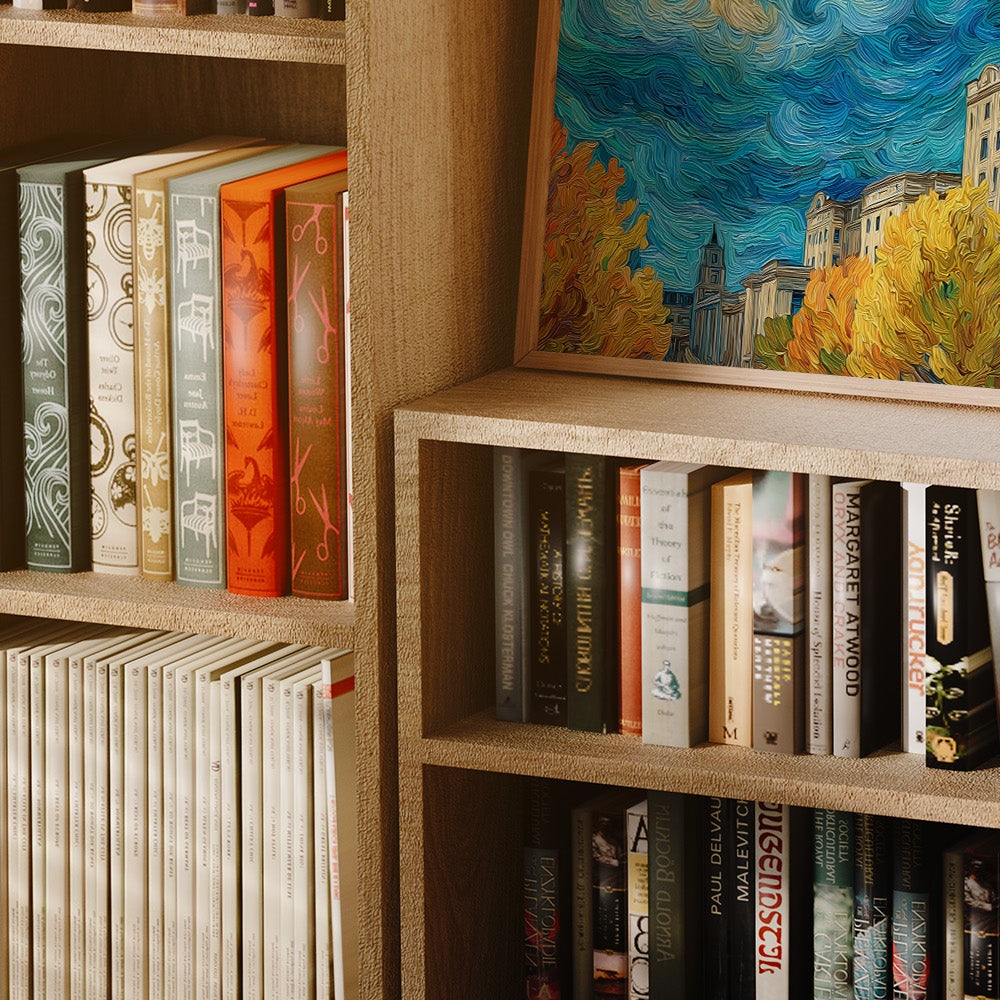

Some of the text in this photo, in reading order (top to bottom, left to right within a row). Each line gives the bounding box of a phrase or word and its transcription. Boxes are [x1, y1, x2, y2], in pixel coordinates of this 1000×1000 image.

[661, 503, 671, 513] of
[943, 503, 962, 565] Shriek:
[502, 455, 514, 690] DOWNTOWN OWL CHUCK KLOSTERMAN
[650, 537, 682, 551] Theory
[650, 570, 682, 581] Fiction
[834, 492, 846, 670] ORYX AND CRAKE
[845, 493, 860, 697] MARGARET ATWOOD
[812, 590, 822, 624] House
[711, 798, 722, 915] PAUL DELVAU
